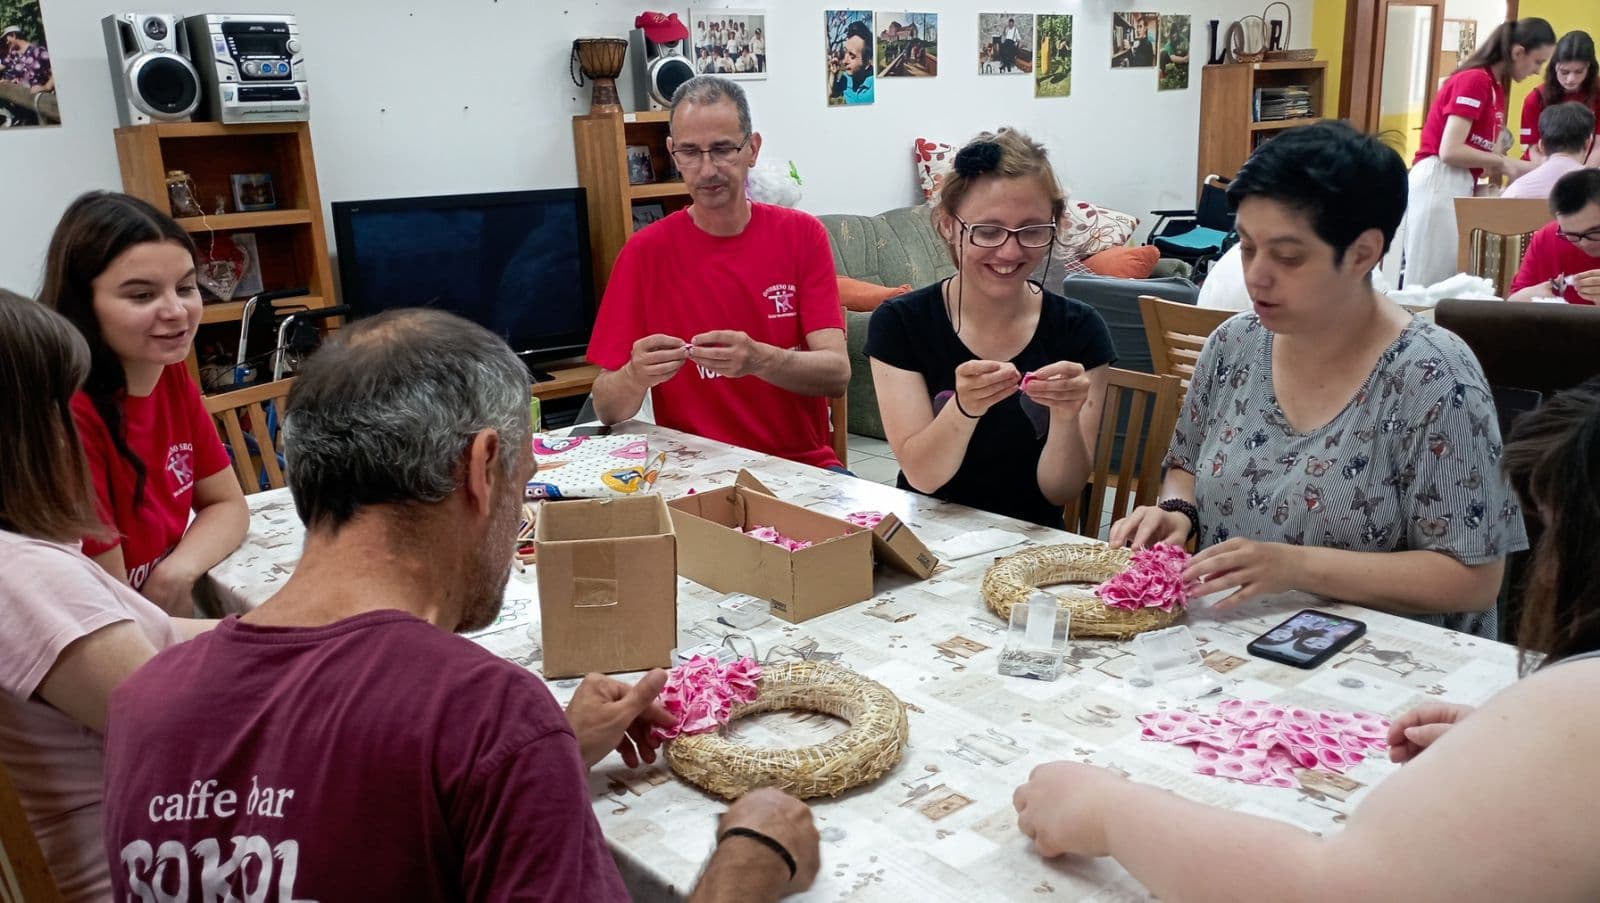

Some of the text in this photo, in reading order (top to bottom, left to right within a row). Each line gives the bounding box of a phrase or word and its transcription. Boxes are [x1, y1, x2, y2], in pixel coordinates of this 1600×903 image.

[149, 775, 295, 822] caffe bar
[120, 835, 321, 903] SOKOL
